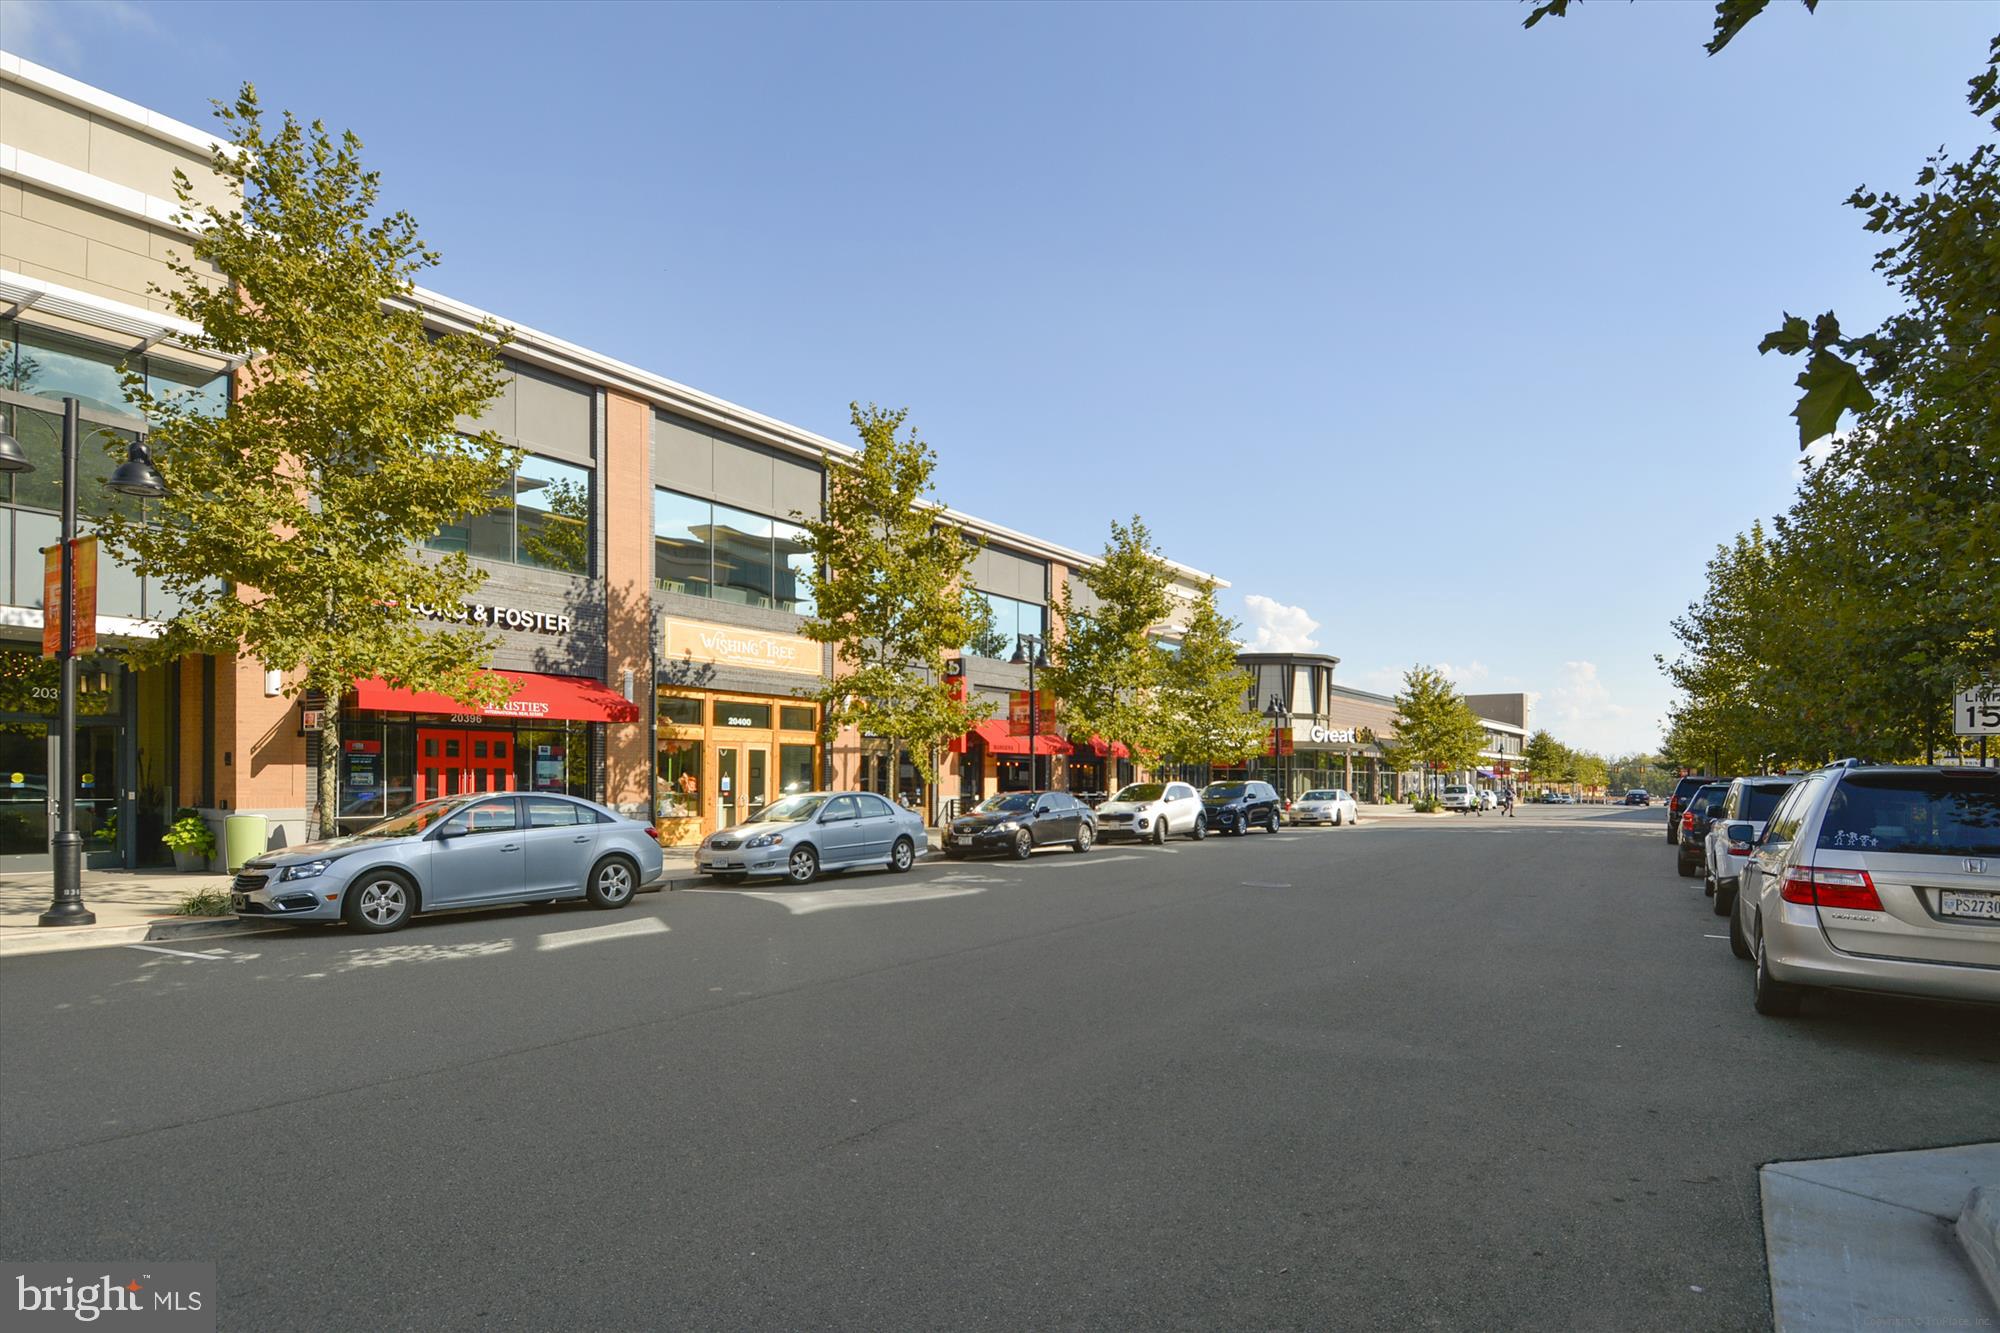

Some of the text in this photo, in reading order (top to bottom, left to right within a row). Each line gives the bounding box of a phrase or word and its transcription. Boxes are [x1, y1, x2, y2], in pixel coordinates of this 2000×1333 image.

[473, 604, 488, 622] &
[494, 606, 570, 632] FOSTER
[699, 631, 759, 656] WISHING
[760, 639, 796, 660] TREE
[31, 687, 60, 699] 203
[450, 713, 482, 724] 20396
[728, 717, 752, 726] 20400
[1966, 706, 2000, 728] 15
[1311, 725, 1355, 744] Great
